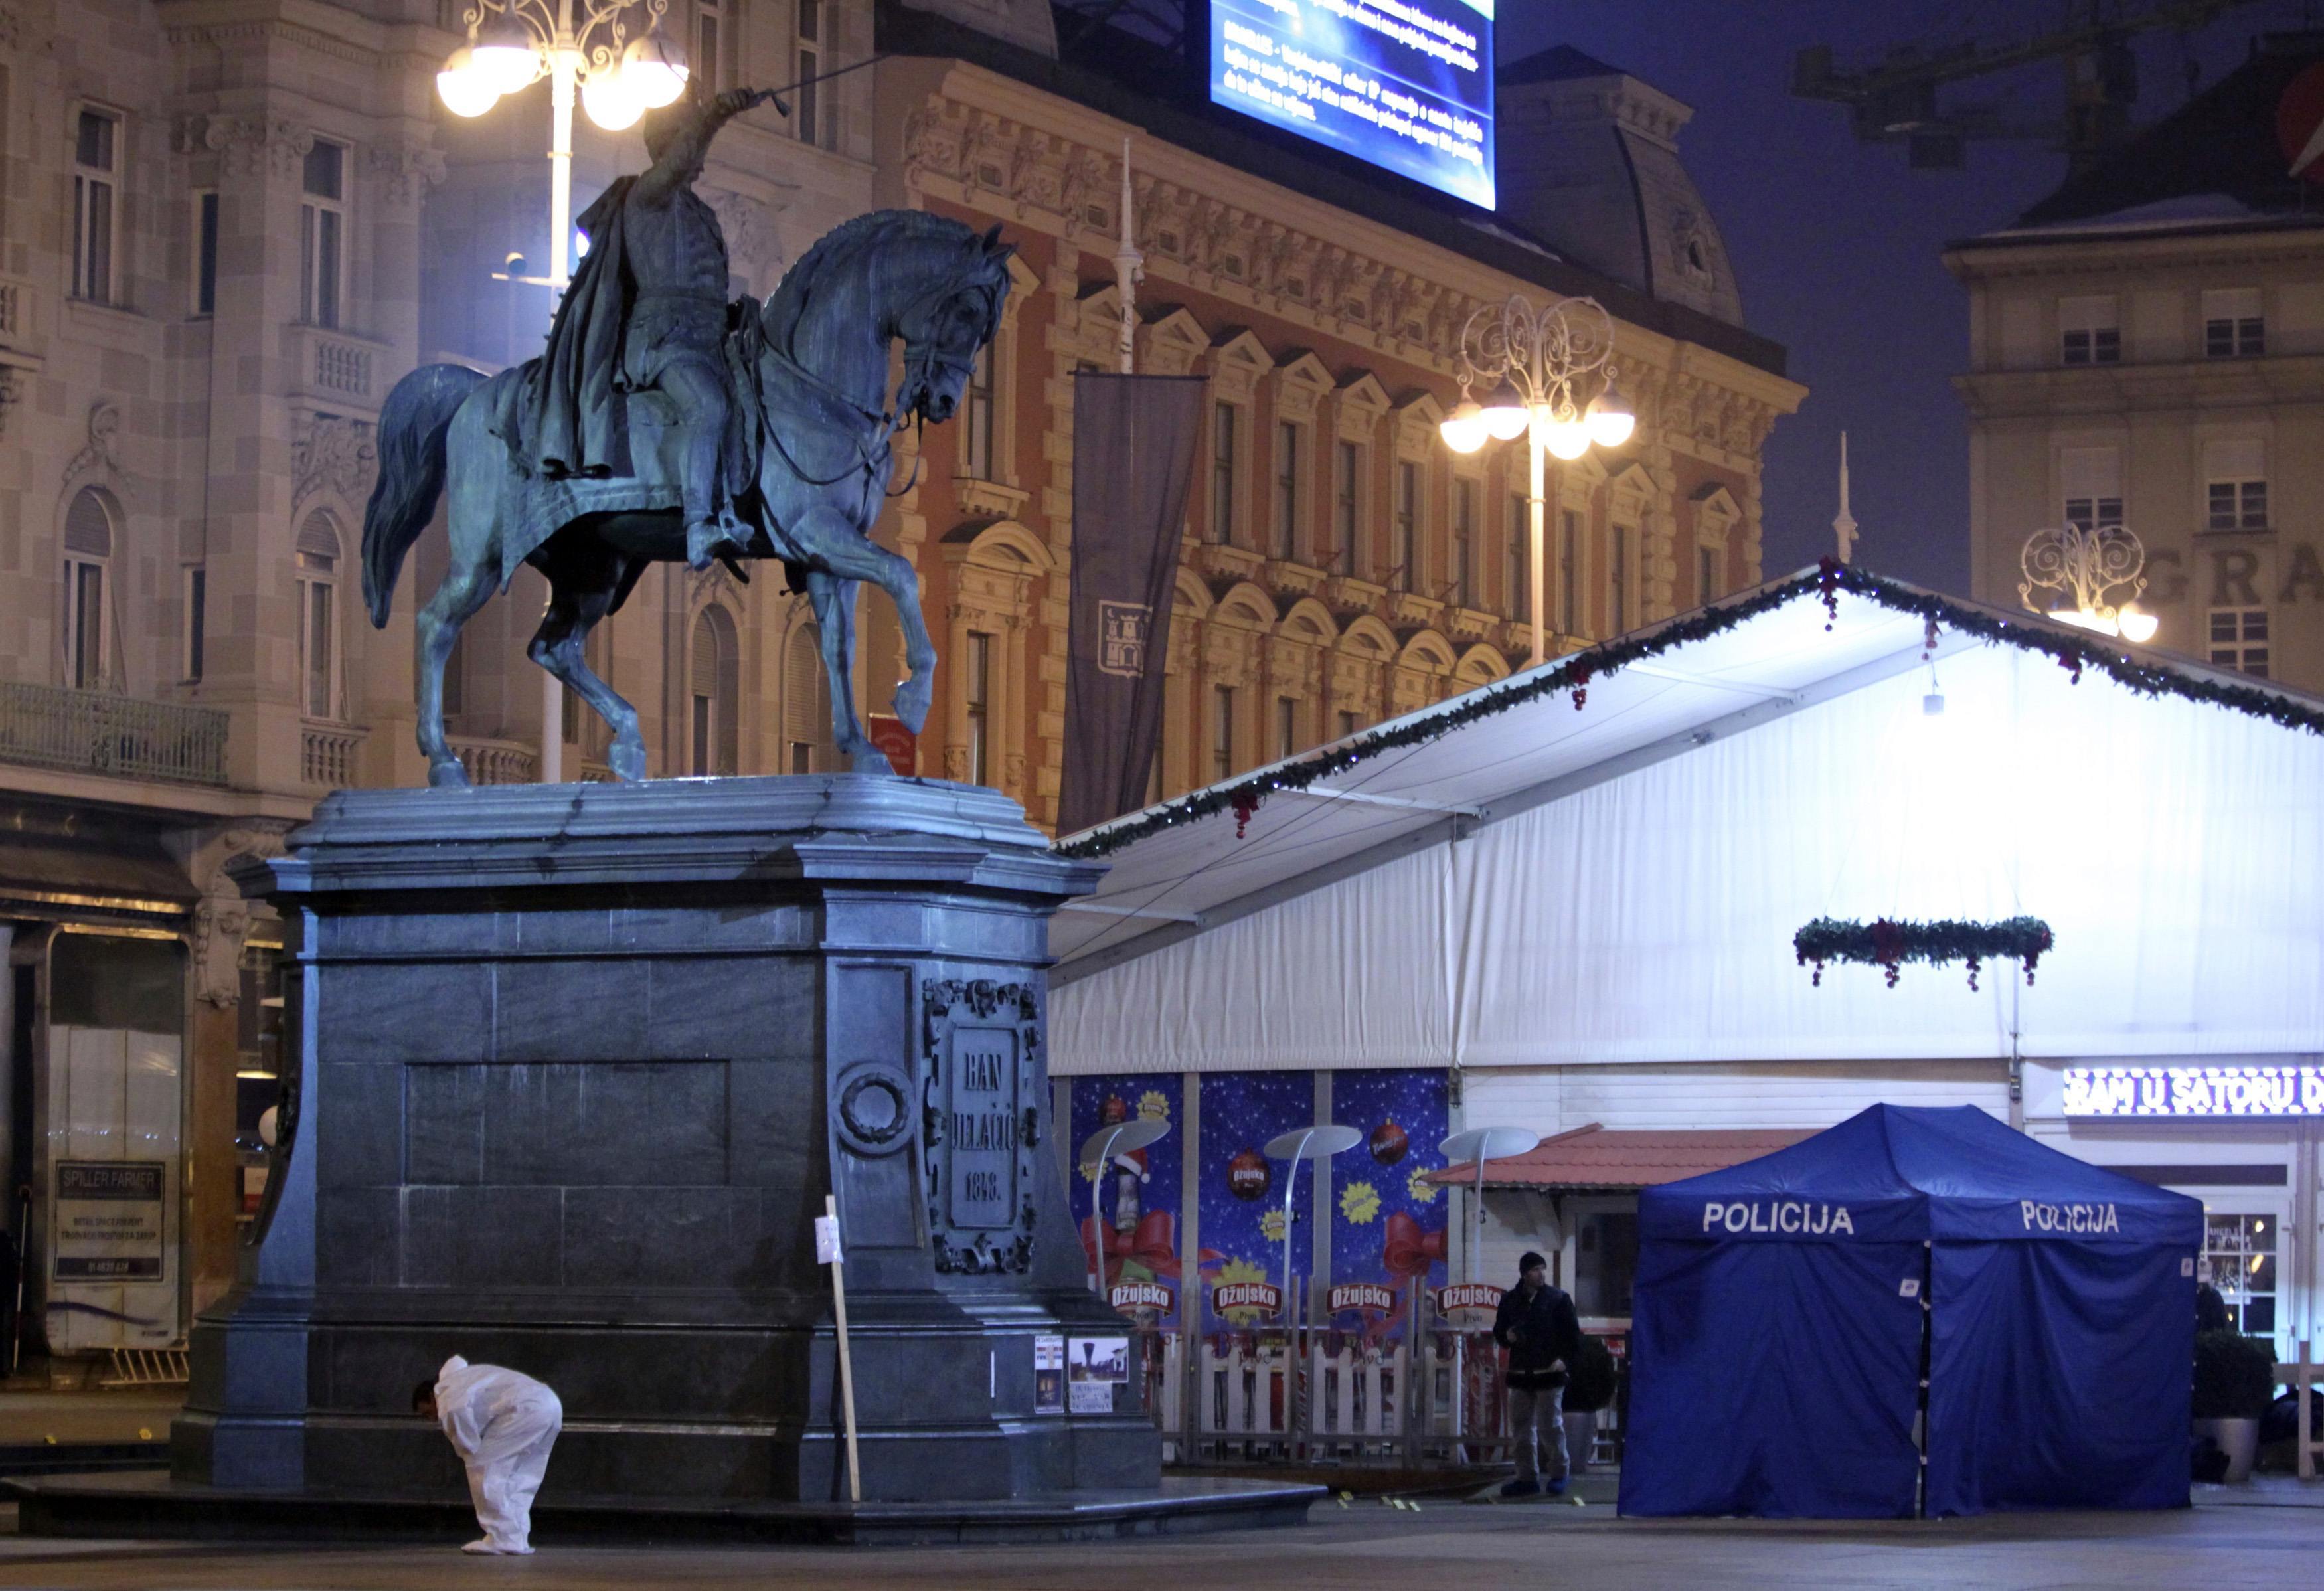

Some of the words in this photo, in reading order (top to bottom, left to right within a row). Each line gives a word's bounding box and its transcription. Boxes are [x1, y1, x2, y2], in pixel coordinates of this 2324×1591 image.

[965, 1052, 1001, 1091] BAN
[2142, 1077, 2165, 1108] U
[64, 1169, 109, 1188] SPILLER
[111, 1171, 155, 1189] FARMER
[1702, 1201, 1854, 1235] POLICIJA
[2021, 1200, 2119, 1233] POLICIJA
[1112, 1284, 1169, 1307] Ožujsko
[1219, 1284, 1276, 1307] Ožujsko
[1332, 1285, 1390, 1309] Ožujsko
[1443, 1285, 1501, 1309] Ožujsko
